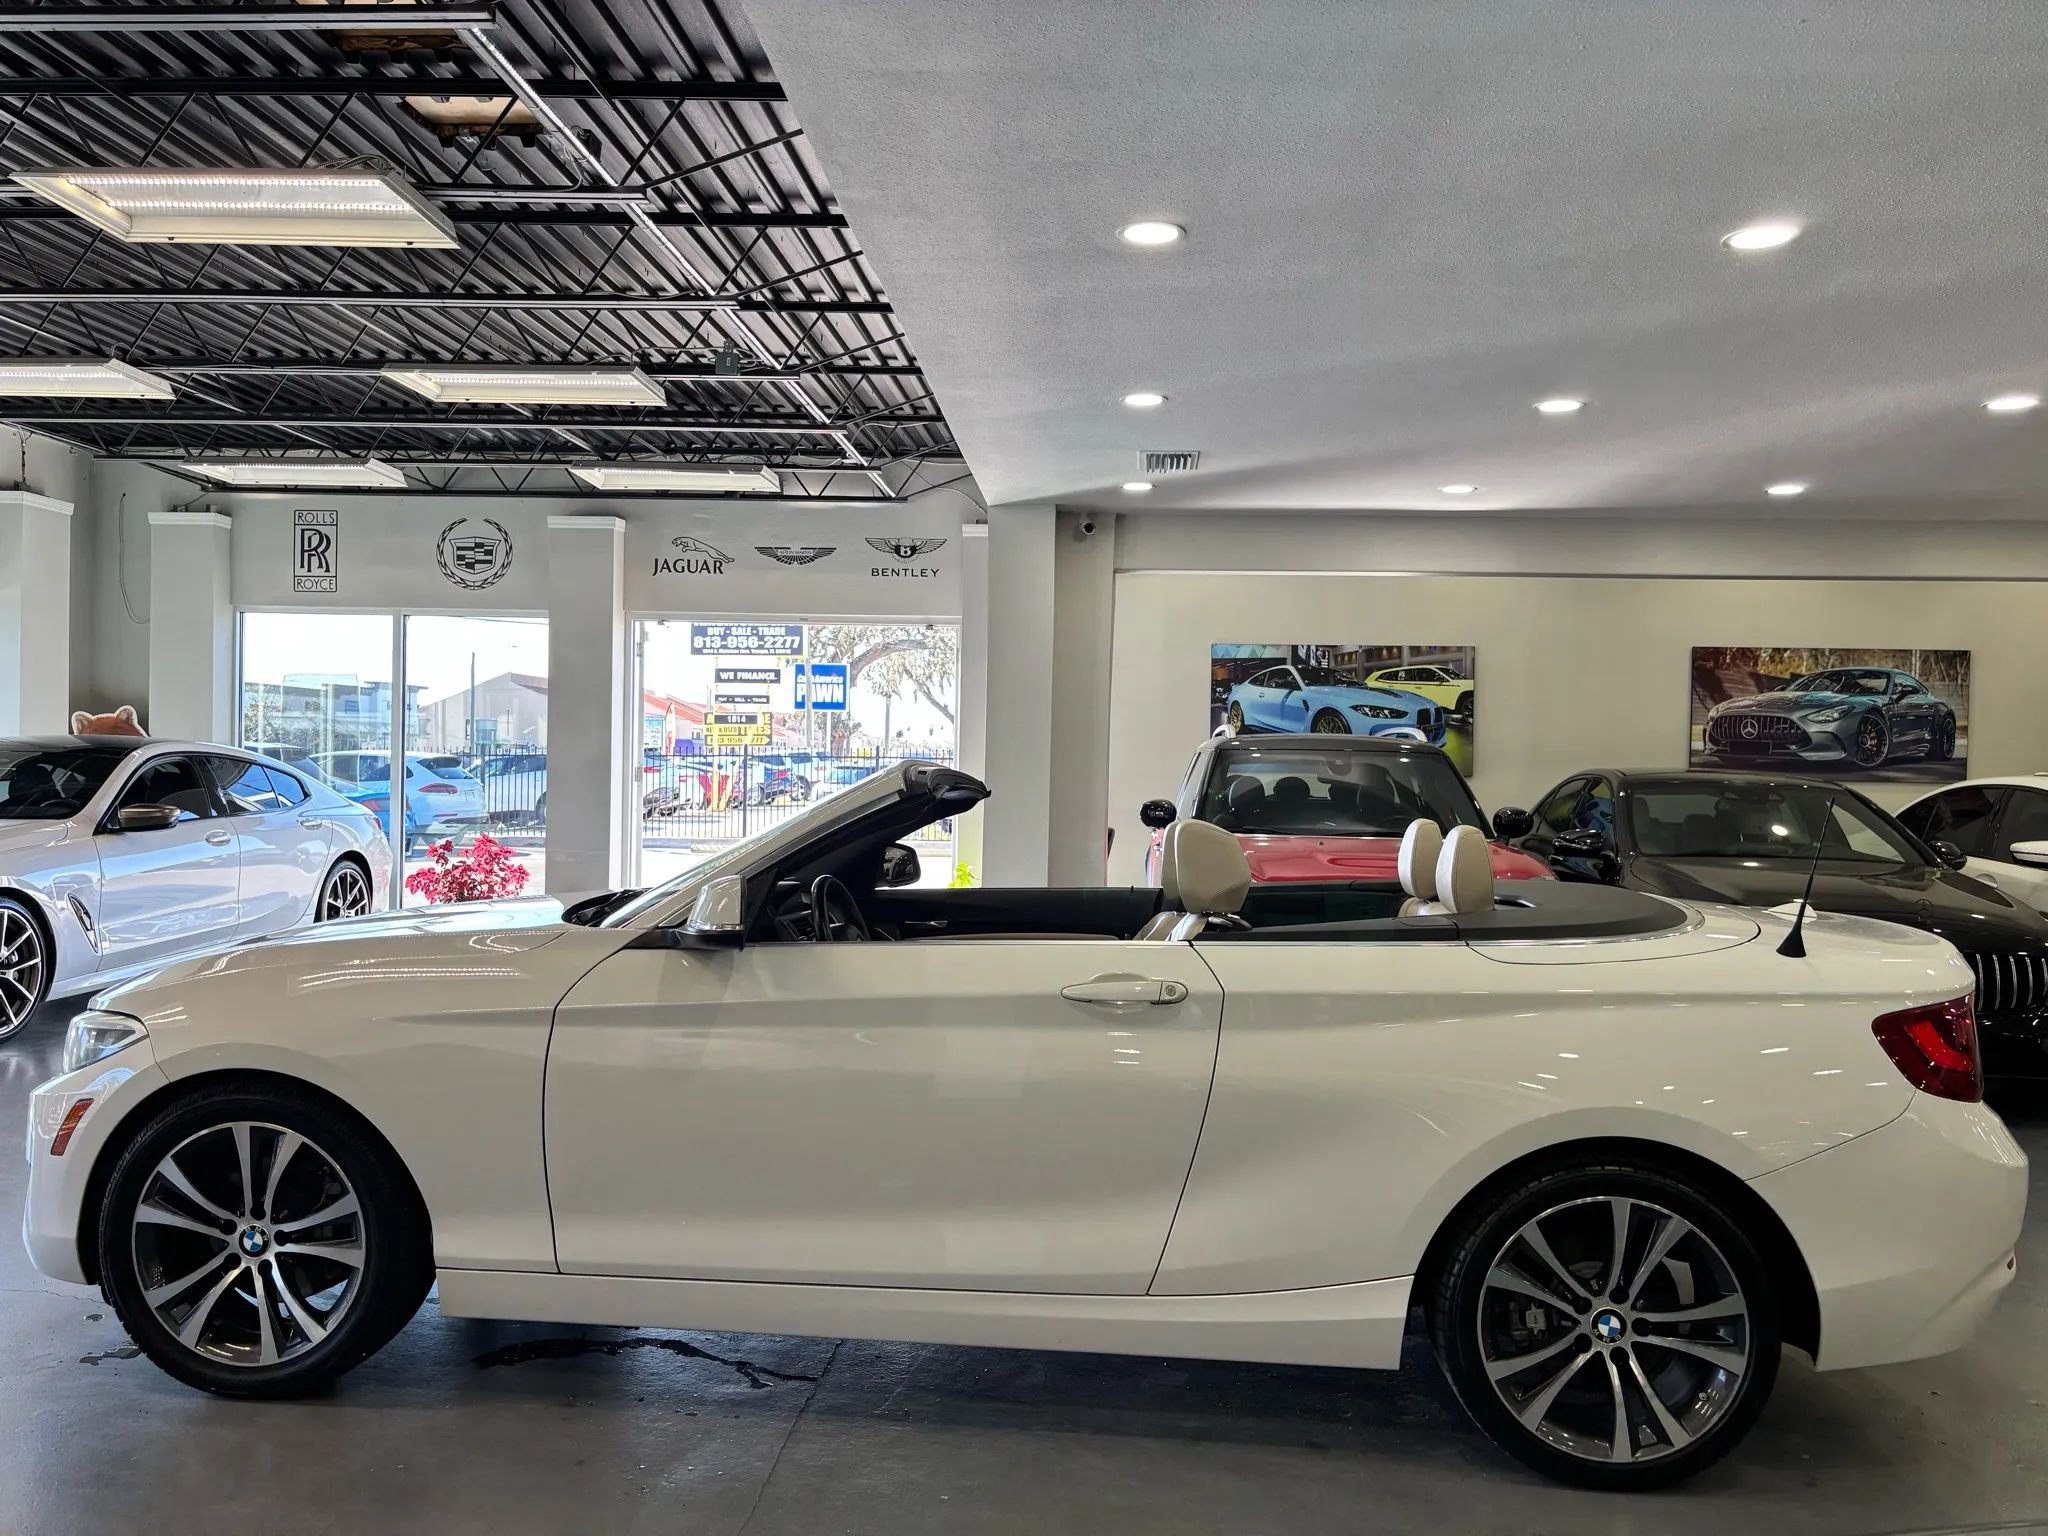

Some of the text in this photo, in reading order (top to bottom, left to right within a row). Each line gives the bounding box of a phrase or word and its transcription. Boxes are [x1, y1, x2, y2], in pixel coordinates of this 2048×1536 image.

[297, 512, 335, 524] ROLLS
[652, 558, 723, 576] JAGUAR
[871, 567, 940, 578] BENTLEY
[296, 579, 334, 591] ROYCE
[707, 626, 786, 635] BUY SALE TRADE
[693, 635, 800, 648] 813-956-2277
[719, 671, 734, 680] WE
